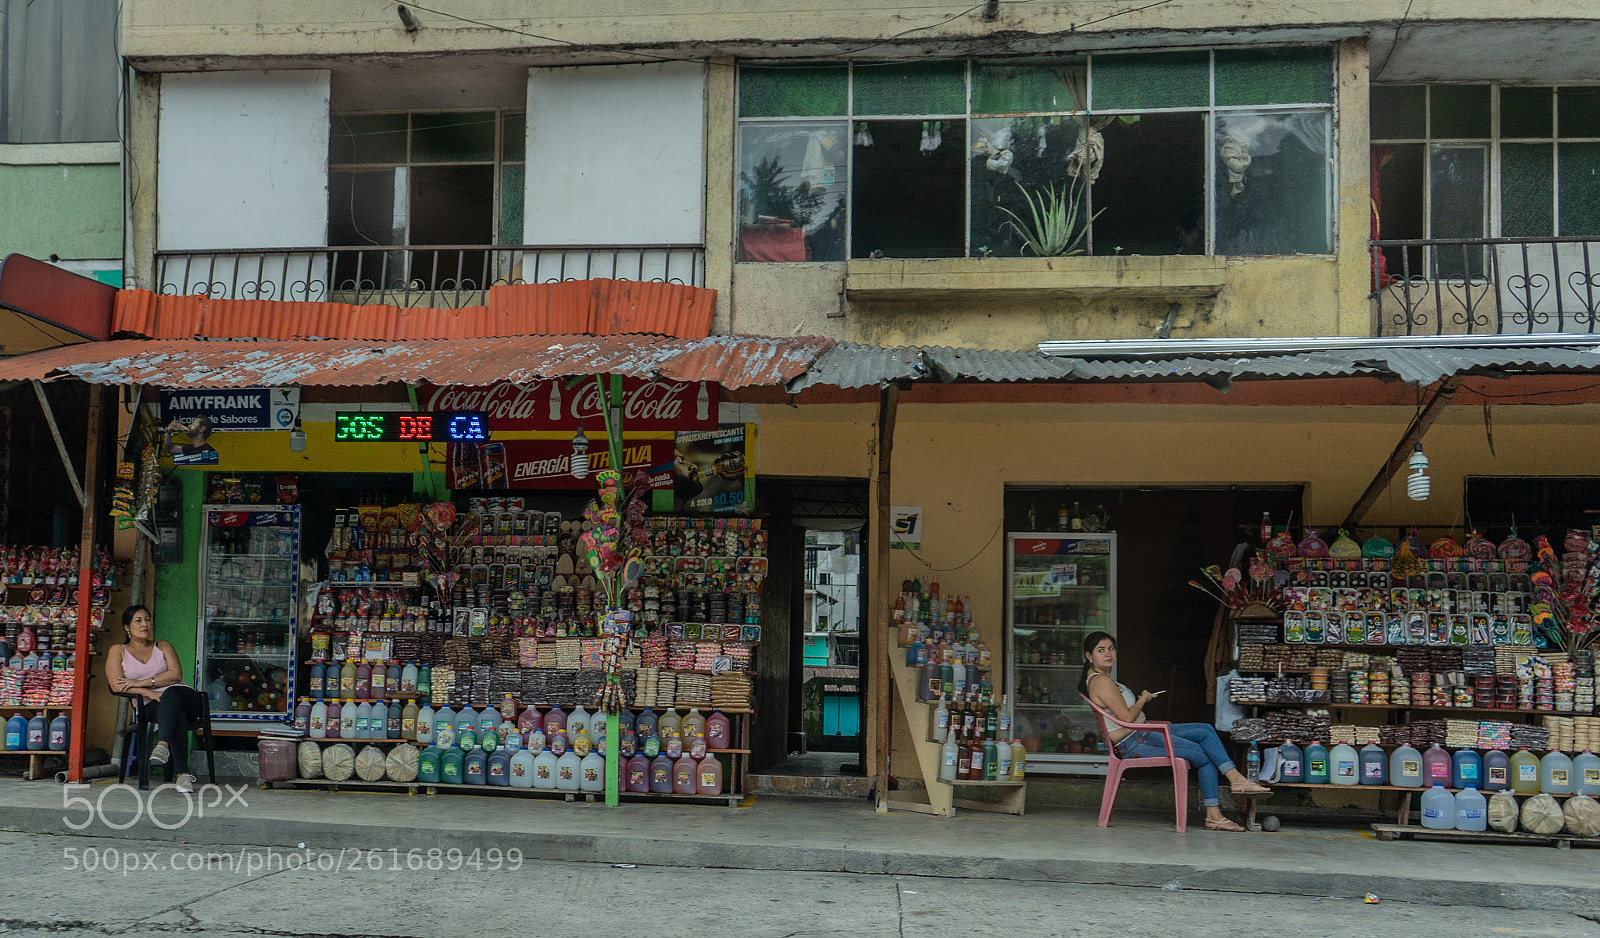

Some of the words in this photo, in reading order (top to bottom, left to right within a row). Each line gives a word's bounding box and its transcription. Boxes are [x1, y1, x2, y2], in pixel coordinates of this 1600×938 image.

[168, 395, 263, 411] AMYFRANK
[427, 381, 544, 419] Coca-Cola
[570, 381, 690, 420] Coc-Cola
[220, 414, 258, 424] Sabores
[399, 416, 433, 439] DE
[450, 416, 485, 439] CA
[514, 454, 570, 478] ENERGÍA
[696, 497, 713, 507] SOLO
[713, 490, 744, 506] $0.50
